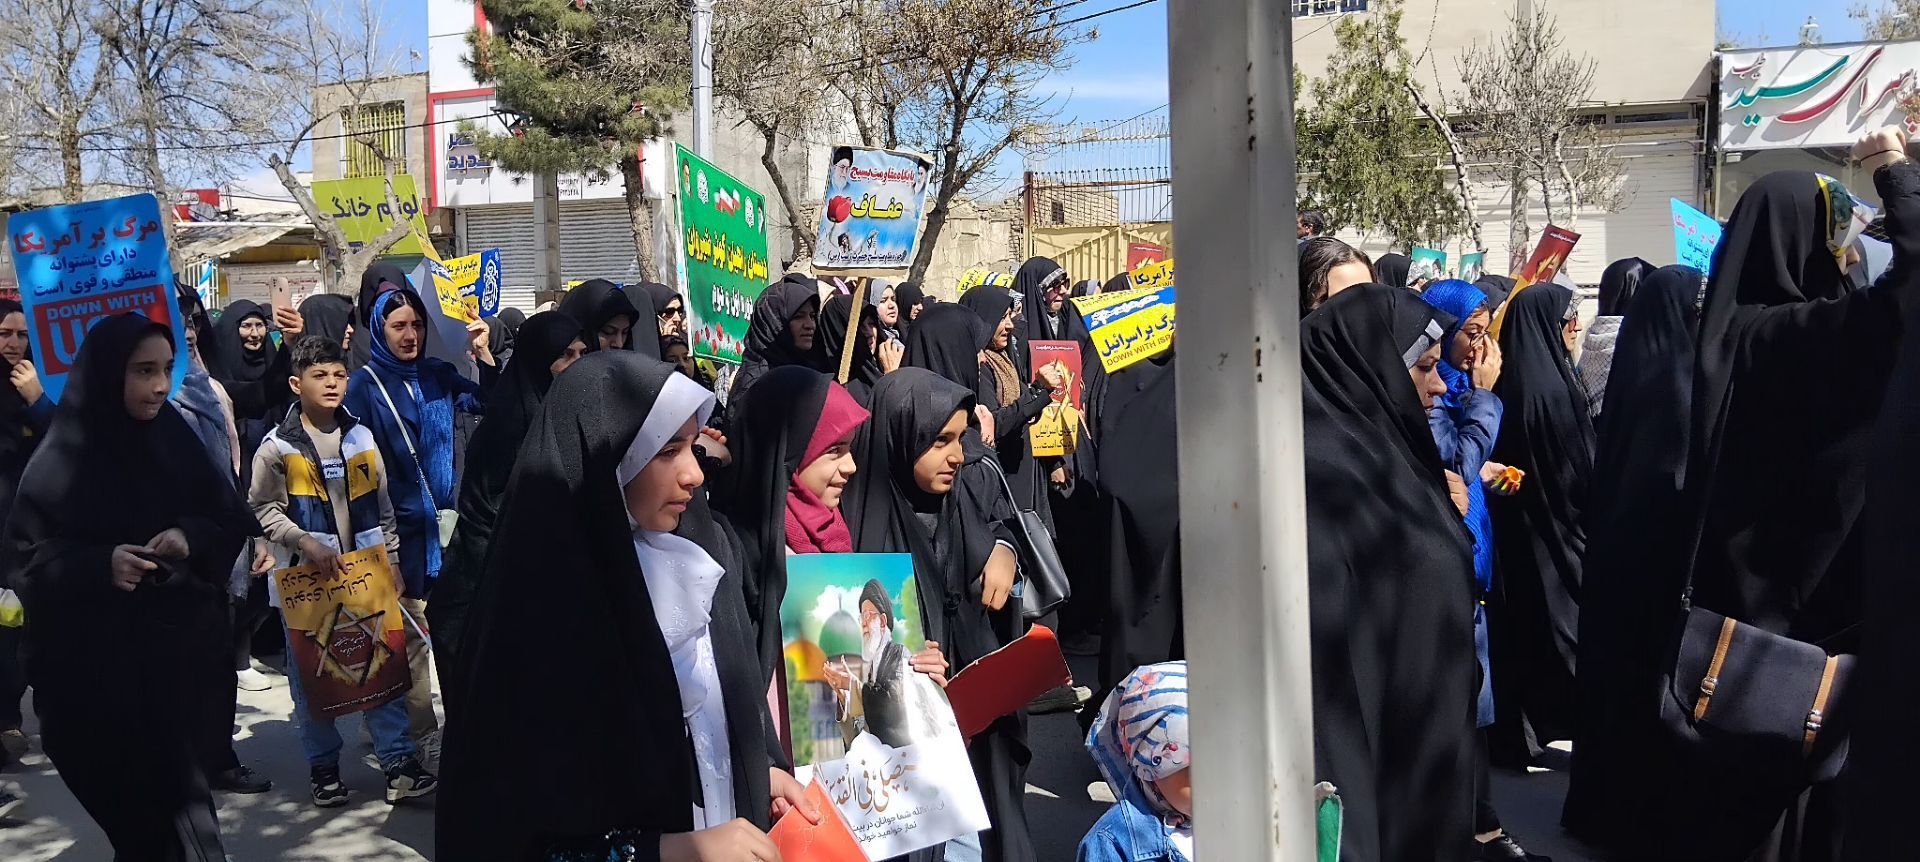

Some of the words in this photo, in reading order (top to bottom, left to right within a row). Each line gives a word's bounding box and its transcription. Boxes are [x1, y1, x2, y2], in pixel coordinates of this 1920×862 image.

[850, 166, 871, 181] بسیج
[333, 196, 372, 218] خانگ
[850, 192, 904, 219] عفاف
[14, 221, 83, 255] آمریکا
[88, 226, 106, 249] بر
[113, 216, 159, 242] مرگ
[50, 256, 98, 274] پشتوانه
[99, 247, 137, 268] دارای
[69, 273, 98, 295] قوی
[101, 278, 109, 290] و
[111, 267, 157, 288] منطقی
[1134, 264, 1167, 285] آمریکا
[33, 281, 65, 297] است
[46, 301, 101, 321] DOWN
[107, 292, 156, 309] WITH
[1101, 325, 1143, 357] اسرائیل
[1145, 325, 1155, 341] بر
[1106, 350, 1134, 366] DOWN
[1134, 342, 1157, 354] WITH
[327, 572, 373, 601] اسرائیل
[866, 821, 874, 830] در
[874, 816, 896, 828] جوانان
[878, 826, 902, 839] خواهید
[904, 821, 917, 832] نماز
